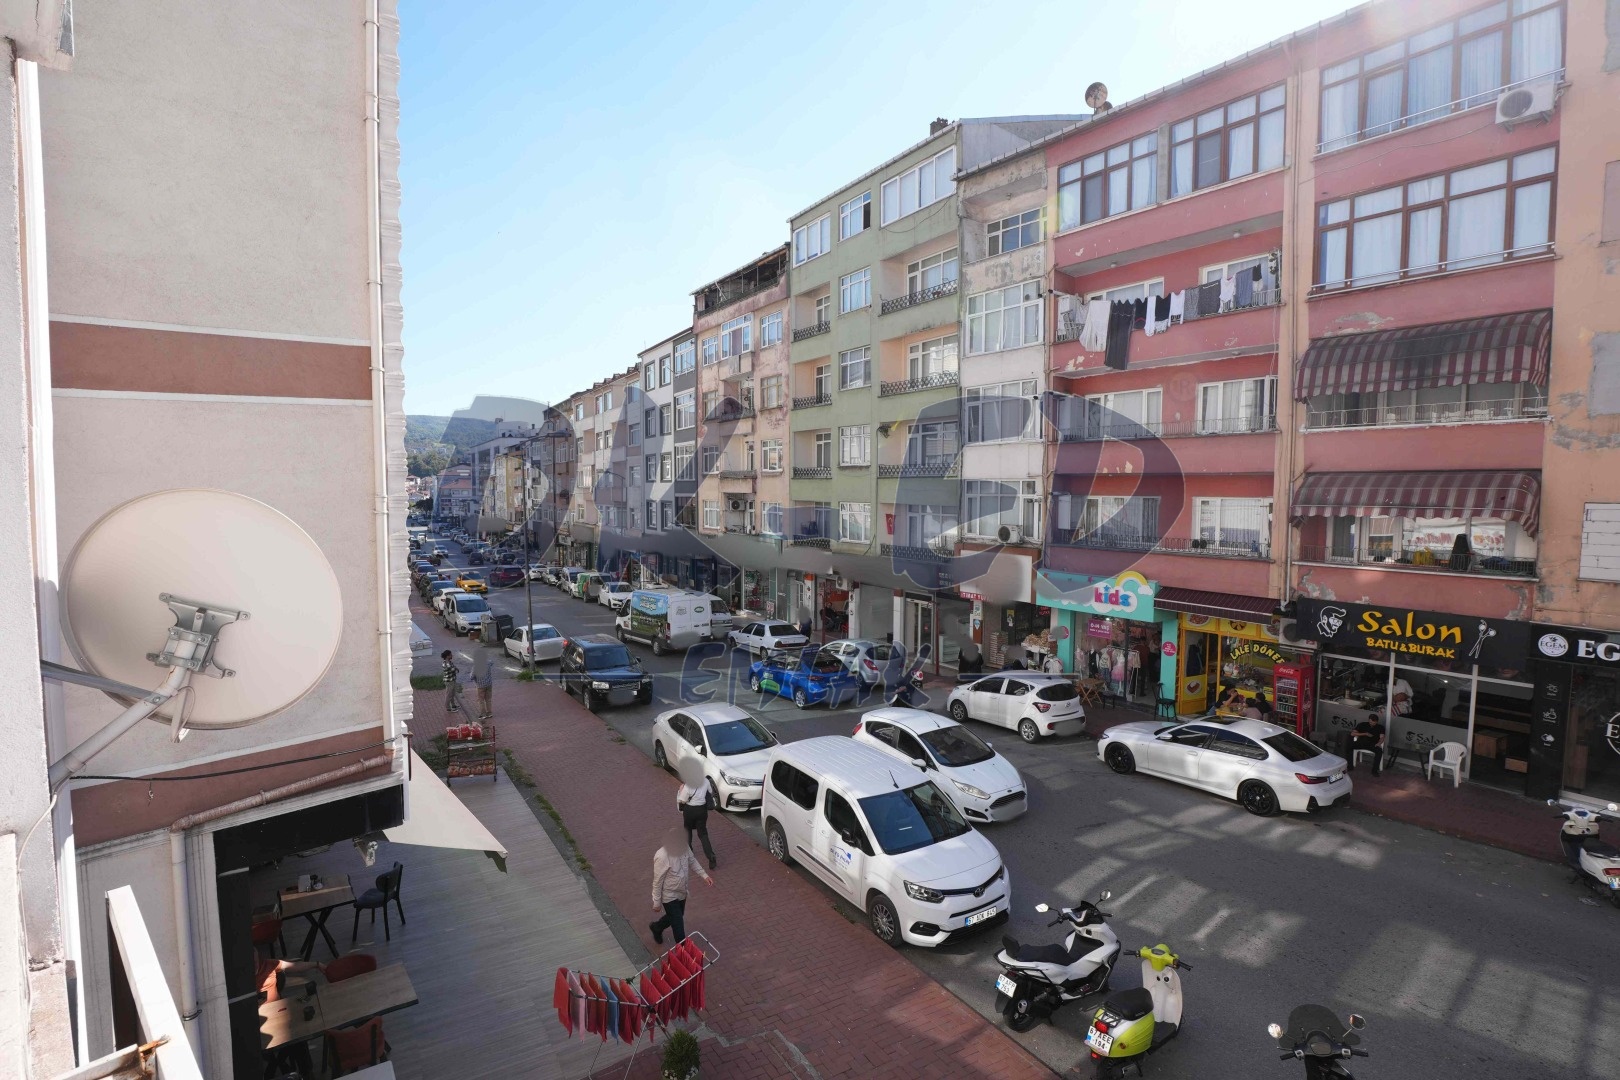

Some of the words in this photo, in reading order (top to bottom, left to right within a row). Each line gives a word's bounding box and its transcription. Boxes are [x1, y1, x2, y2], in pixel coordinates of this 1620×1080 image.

[1094, 584, 1132, 607] kids
[1357, 610, 1463, 645] Salon
[1229, 644, 1250, 660] LALE
[1366, 637, 1456, 660] BATU&BURAK
[1540, 640, 1567, 650] EGEM
[1089, 1027, 1097, 1036] 67
[1097, 1032, 1112, 1045] AEE
[1094, 1038, 1106, 1050] 194
